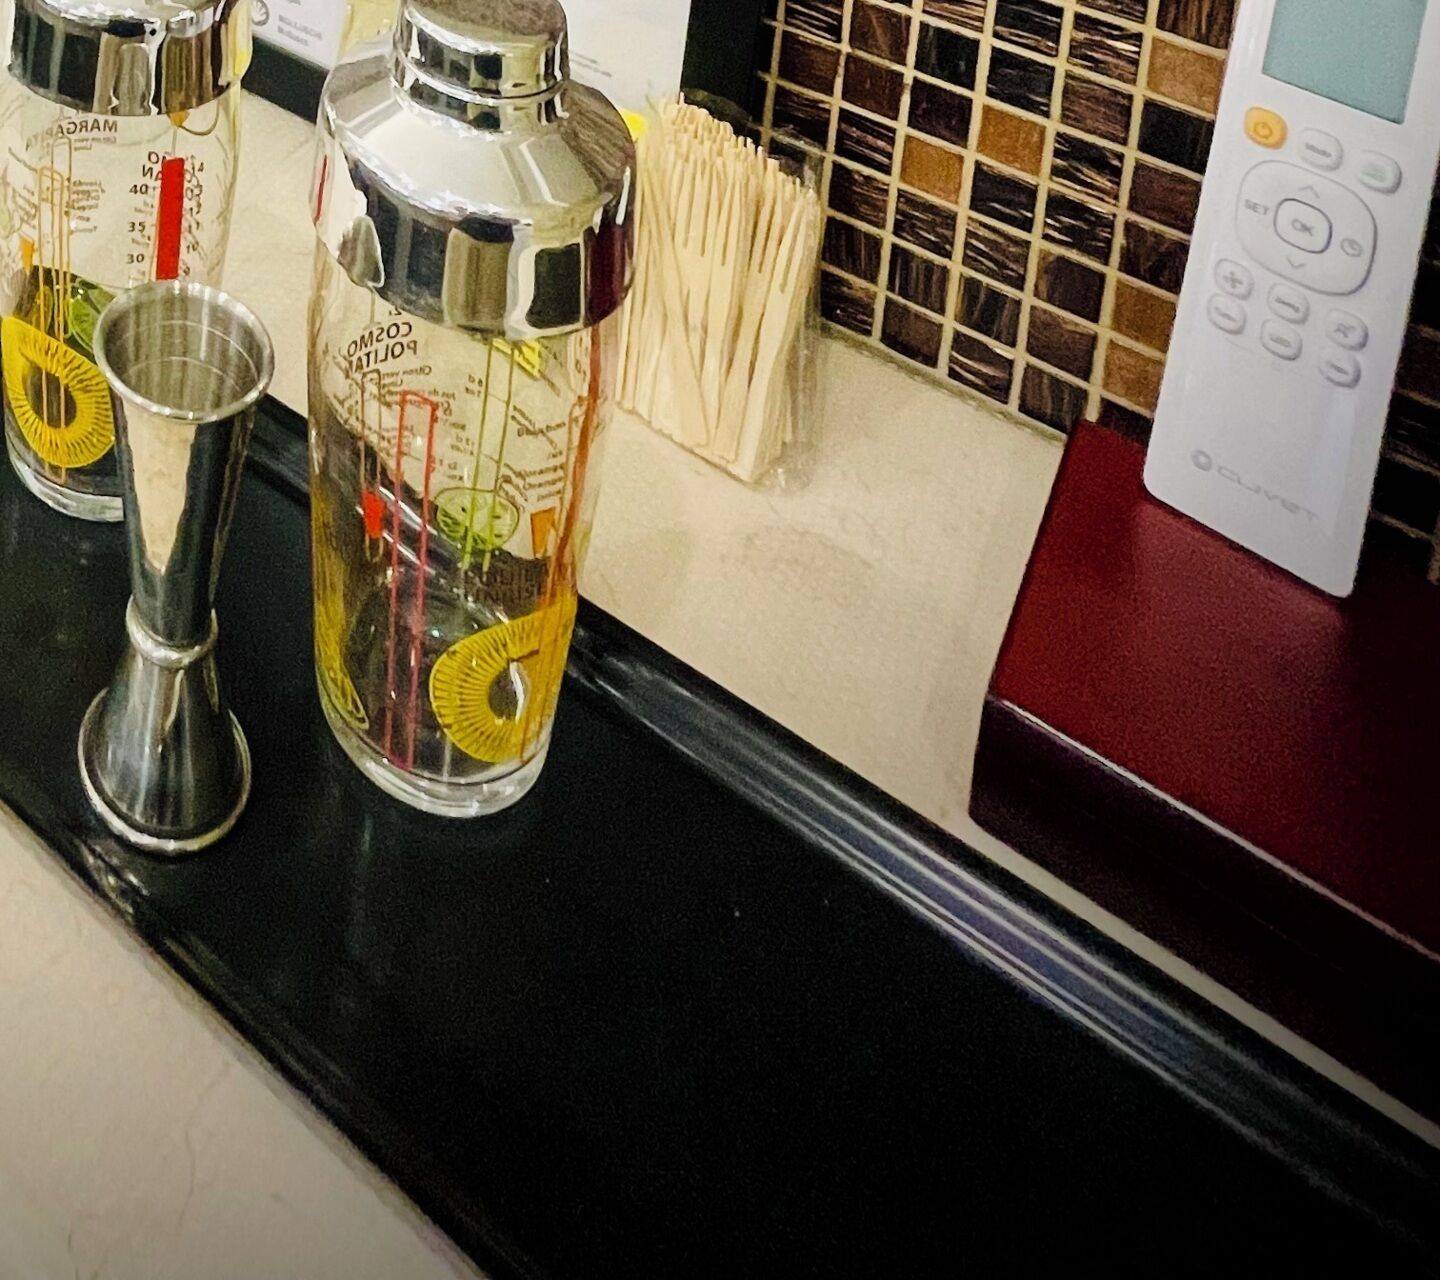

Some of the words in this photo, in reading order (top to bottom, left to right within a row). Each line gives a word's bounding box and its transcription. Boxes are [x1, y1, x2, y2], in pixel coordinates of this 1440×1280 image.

[129, 184, 149, 195] 40
[1244, 198, 1270, 216] SET
[128, 221, 146, 233] 35
[1291, 218, 1314, 237] OK
[126, 253, 145, 265] 30
